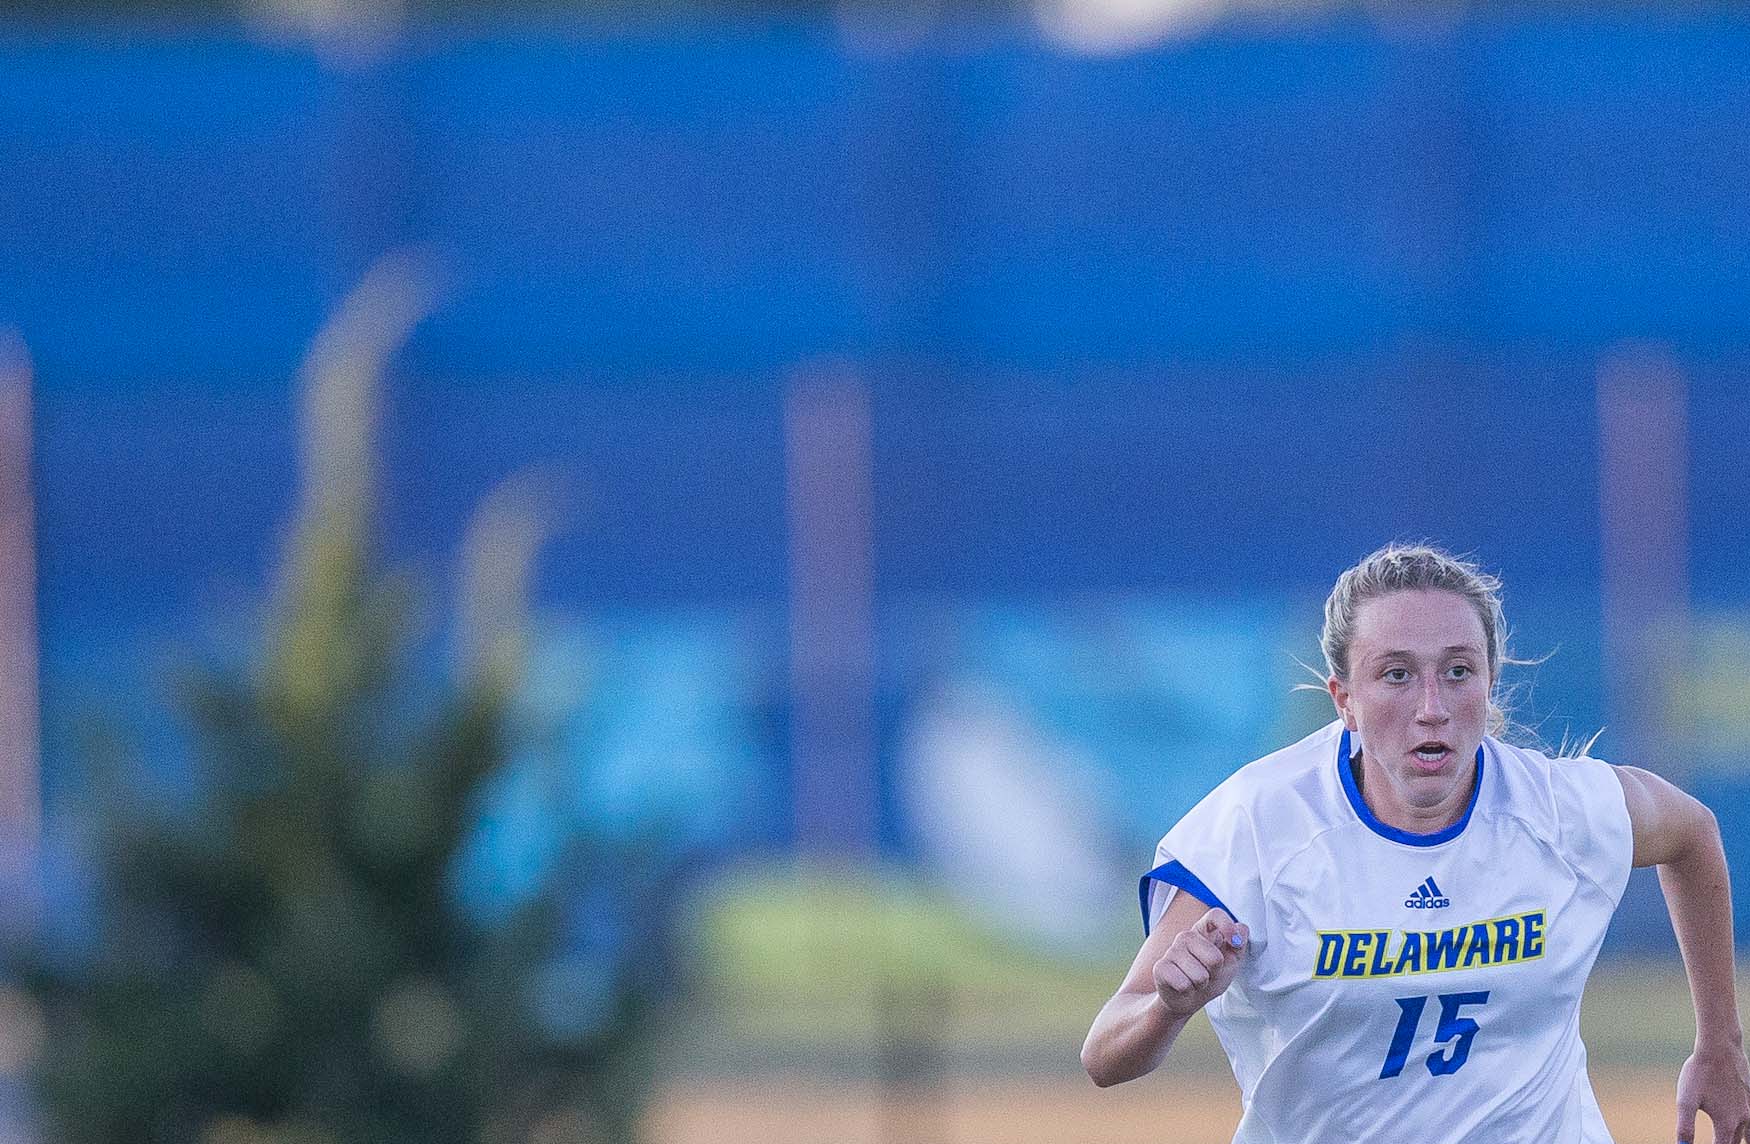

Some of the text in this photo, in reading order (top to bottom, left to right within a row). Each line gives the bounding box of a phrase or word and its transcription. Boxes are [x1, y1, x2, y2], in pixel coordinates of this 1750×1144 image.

[1404, 897, 1450, 909] adidas
[1312, 908, 1546, 981] DELAWARE
[1379, 990, 1490, 1080] 15
